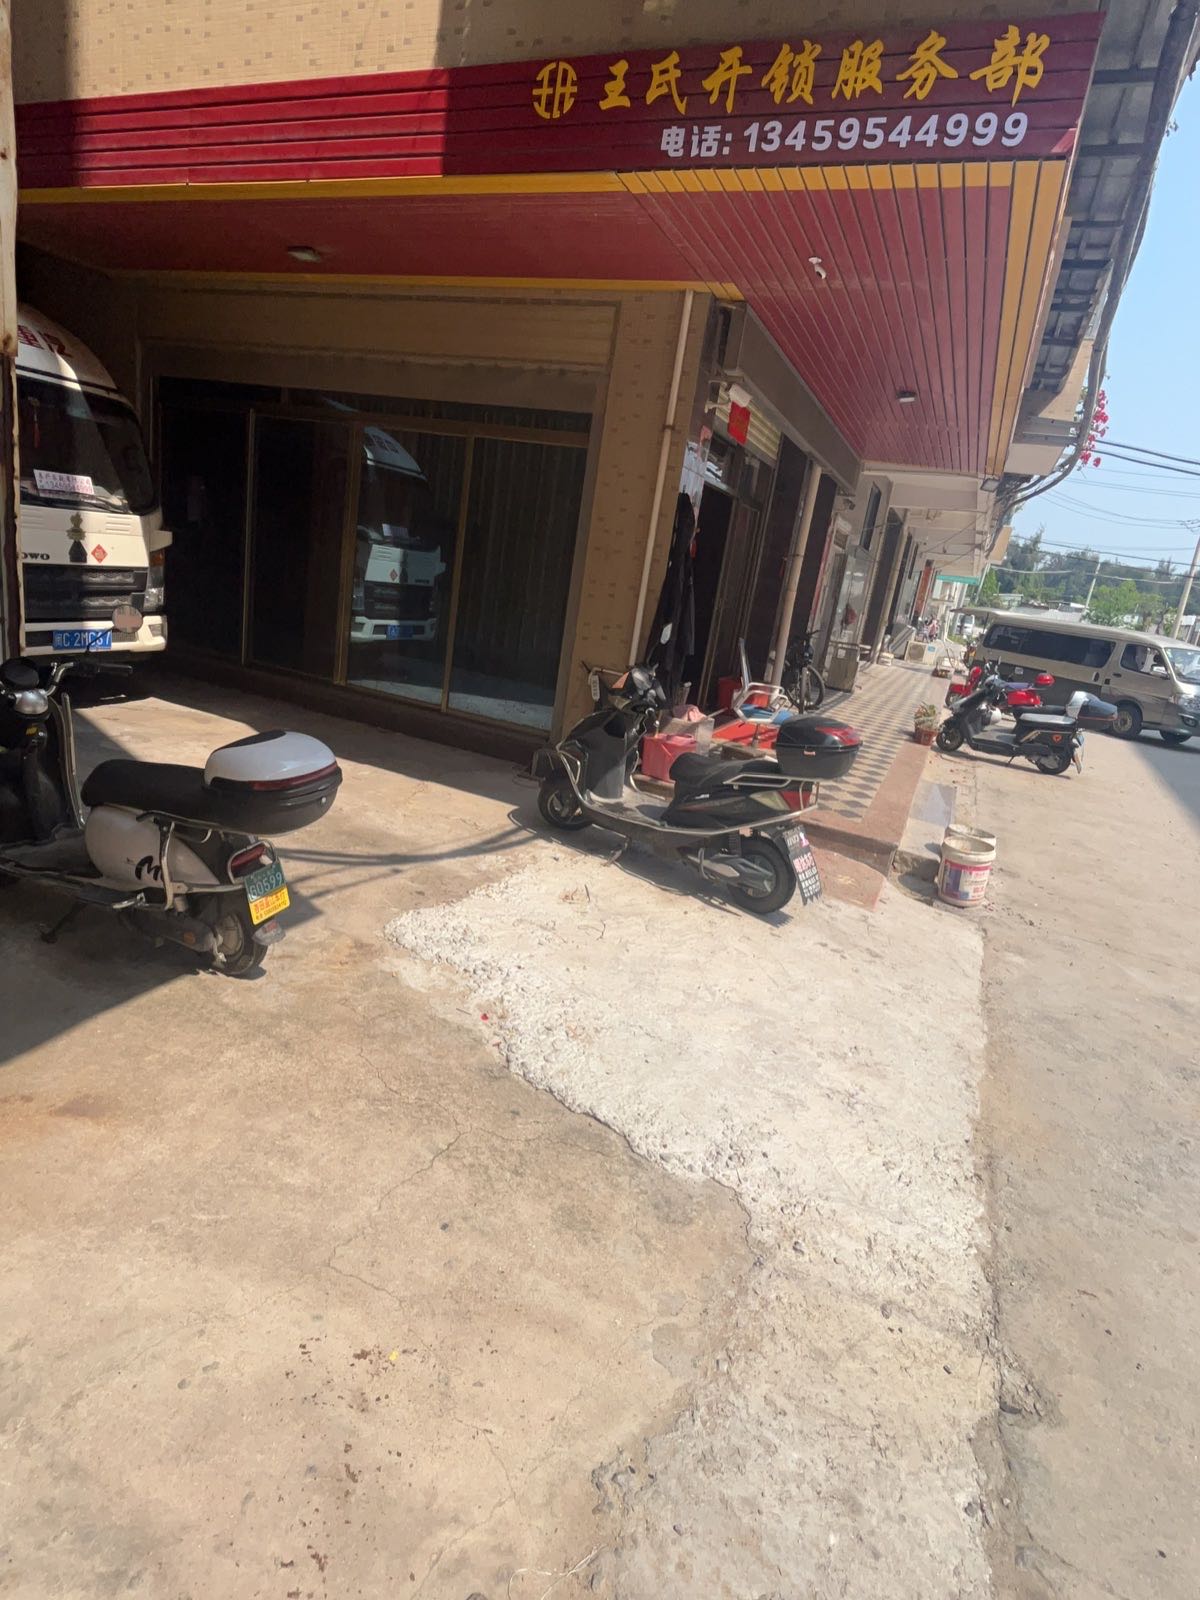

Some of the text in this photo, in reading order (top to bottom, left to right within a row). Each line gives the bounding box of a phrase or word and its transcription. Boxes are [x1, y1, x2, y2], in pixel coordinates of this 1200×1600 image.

[598, 24, 1050, 115] 王氏开锁服务部
